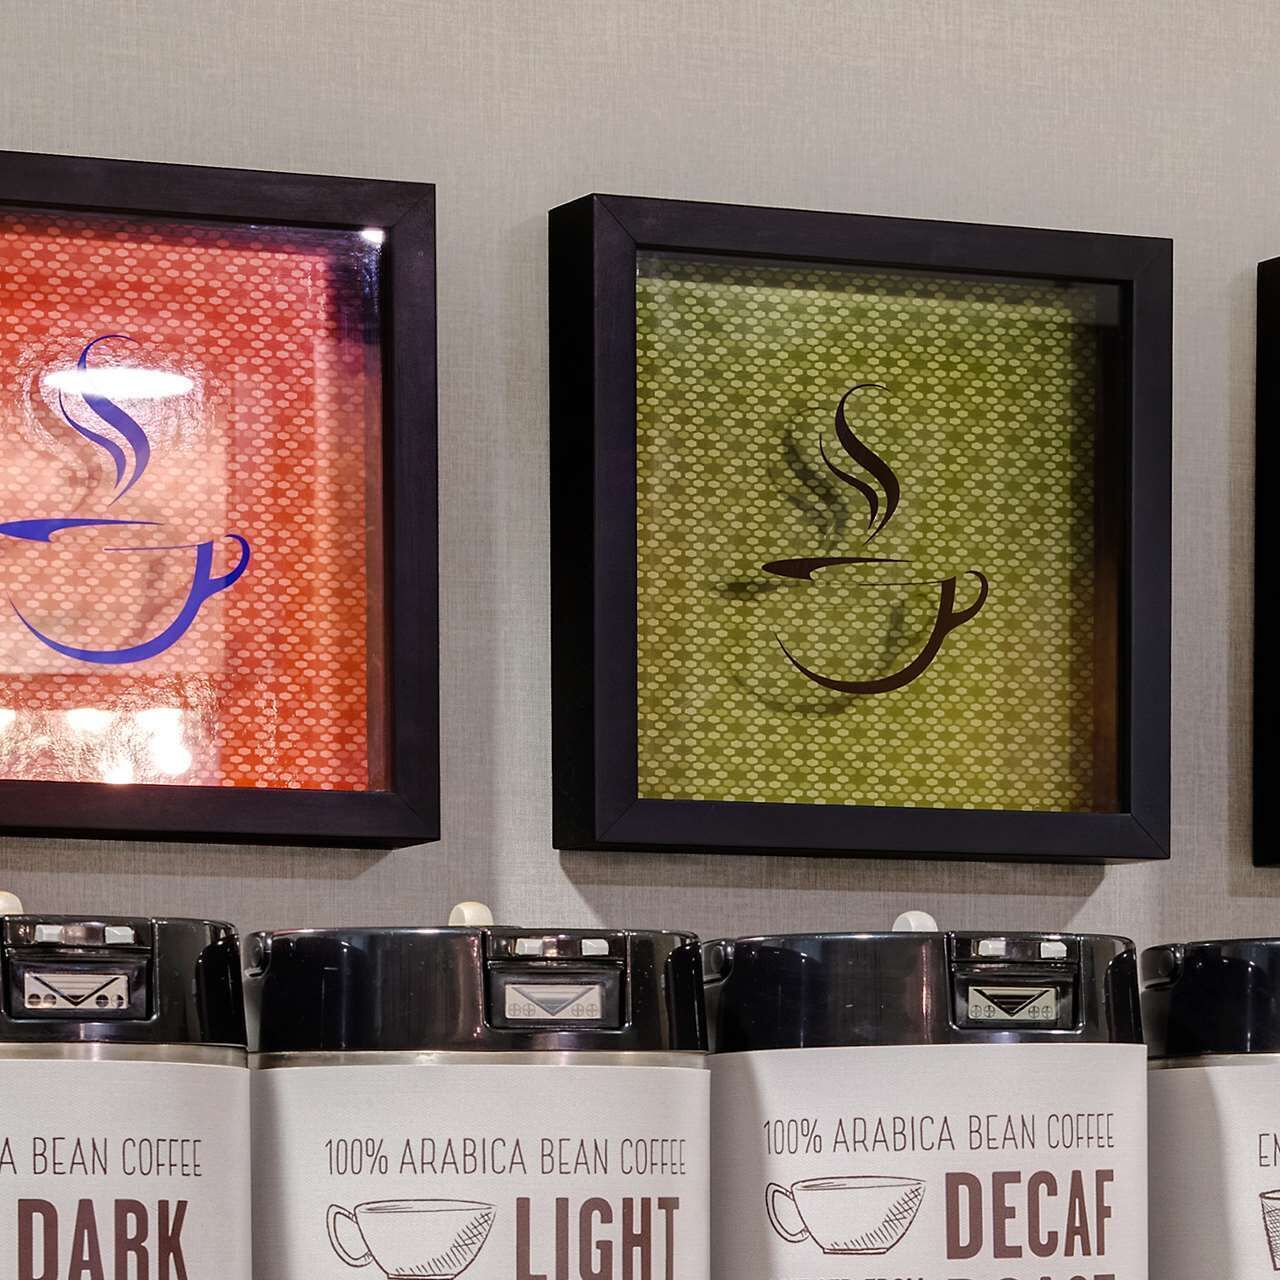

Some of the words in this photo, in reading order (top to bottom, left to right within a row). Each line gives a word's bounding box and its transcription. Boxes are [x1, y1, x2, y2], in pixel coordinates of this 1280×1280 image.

[764, 1118, 822, 1155] 100%
[833, 1116, 955, 1152] ARABICA
[969, 1115, 1035, 1150] BEAN
[1048, 1113, 1114, 1149] COFFEE
[33, 1137, 107, 1175] BEAN
[123, 1138, 202, 1176] COFFEE
[325, 1138, 388, 1175] 100%
[400, 1138, 526, 1174] ARABICA
[541, 1138, 607, 1174] BEAN
[621, 1138, 685, 1174] COFFEE
[945, 1169, 1114, 1259] DECAF
